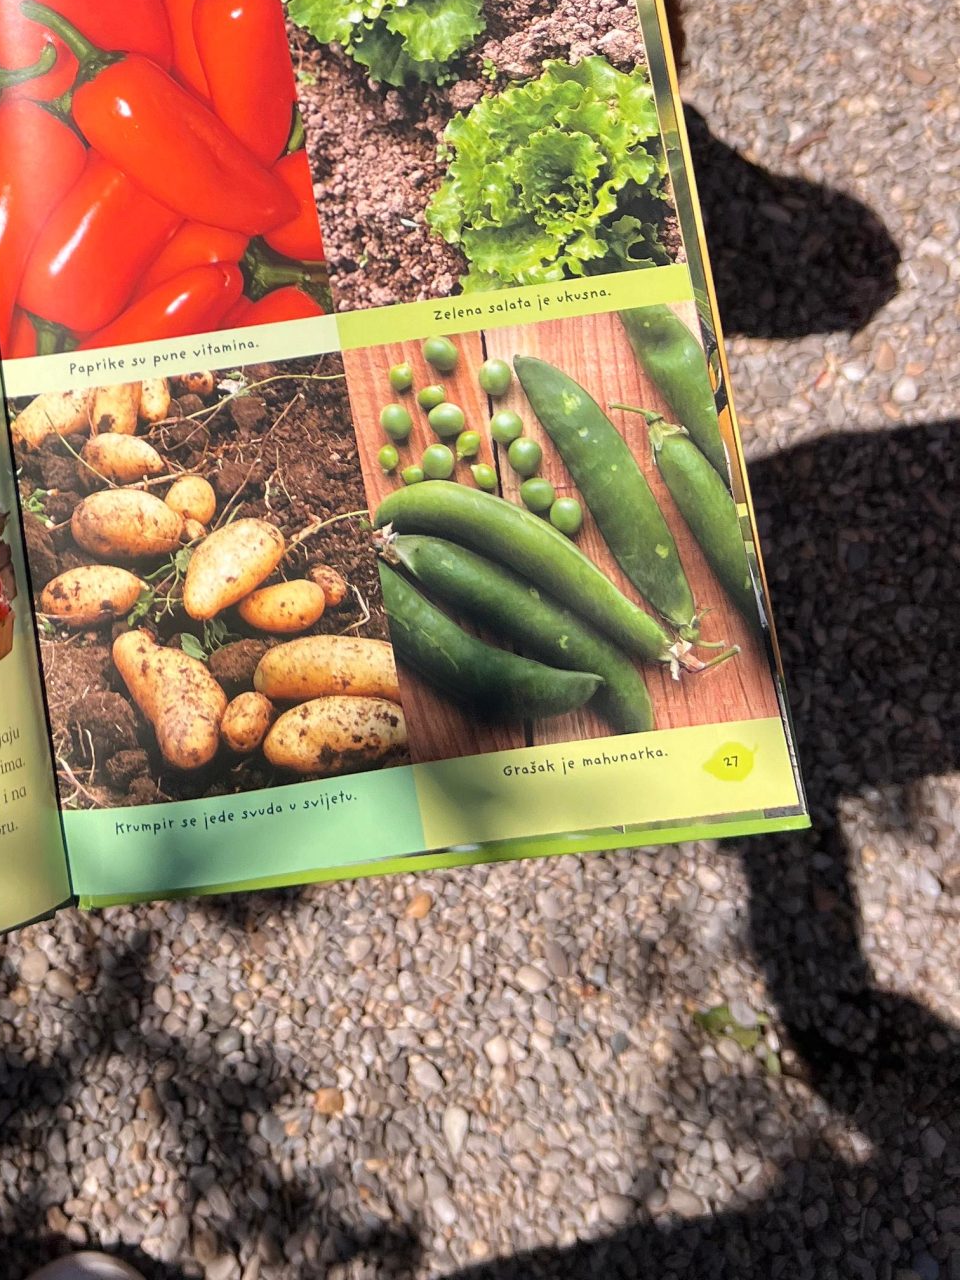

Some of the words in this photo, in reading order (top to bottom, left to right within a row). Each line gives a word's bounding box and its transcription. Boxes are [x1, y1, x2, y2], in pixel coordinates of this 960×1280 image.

[434, 307, 482, 320] Zelena
[488, 297, 531, 313] salata
[538, 295, 550, 311] je
[557, 289, 611, 303] ukusna.
[70, 358, 125, 376] Paprike
[131, 357, 146, 367] su
[153, 351, 186, 367] pune
[193, 339, 259, 357] vitamina.
[503, 759, 555, 777] Grašak
[562, 757, 575, 775] je
[583, 746, 668, 767] mahunarka.
[723, 755, 738, 767] 27
[4, 790, 8, 804] i
[11, 785, 27, 803] na
[115, 817, 174, 835] Krumpir
[181, 816, 196, 828] se
[203, 810, 235, 830] jede
[241, 802, 283, 820] svuda
[303, 790, 357, 810] svijetu.
